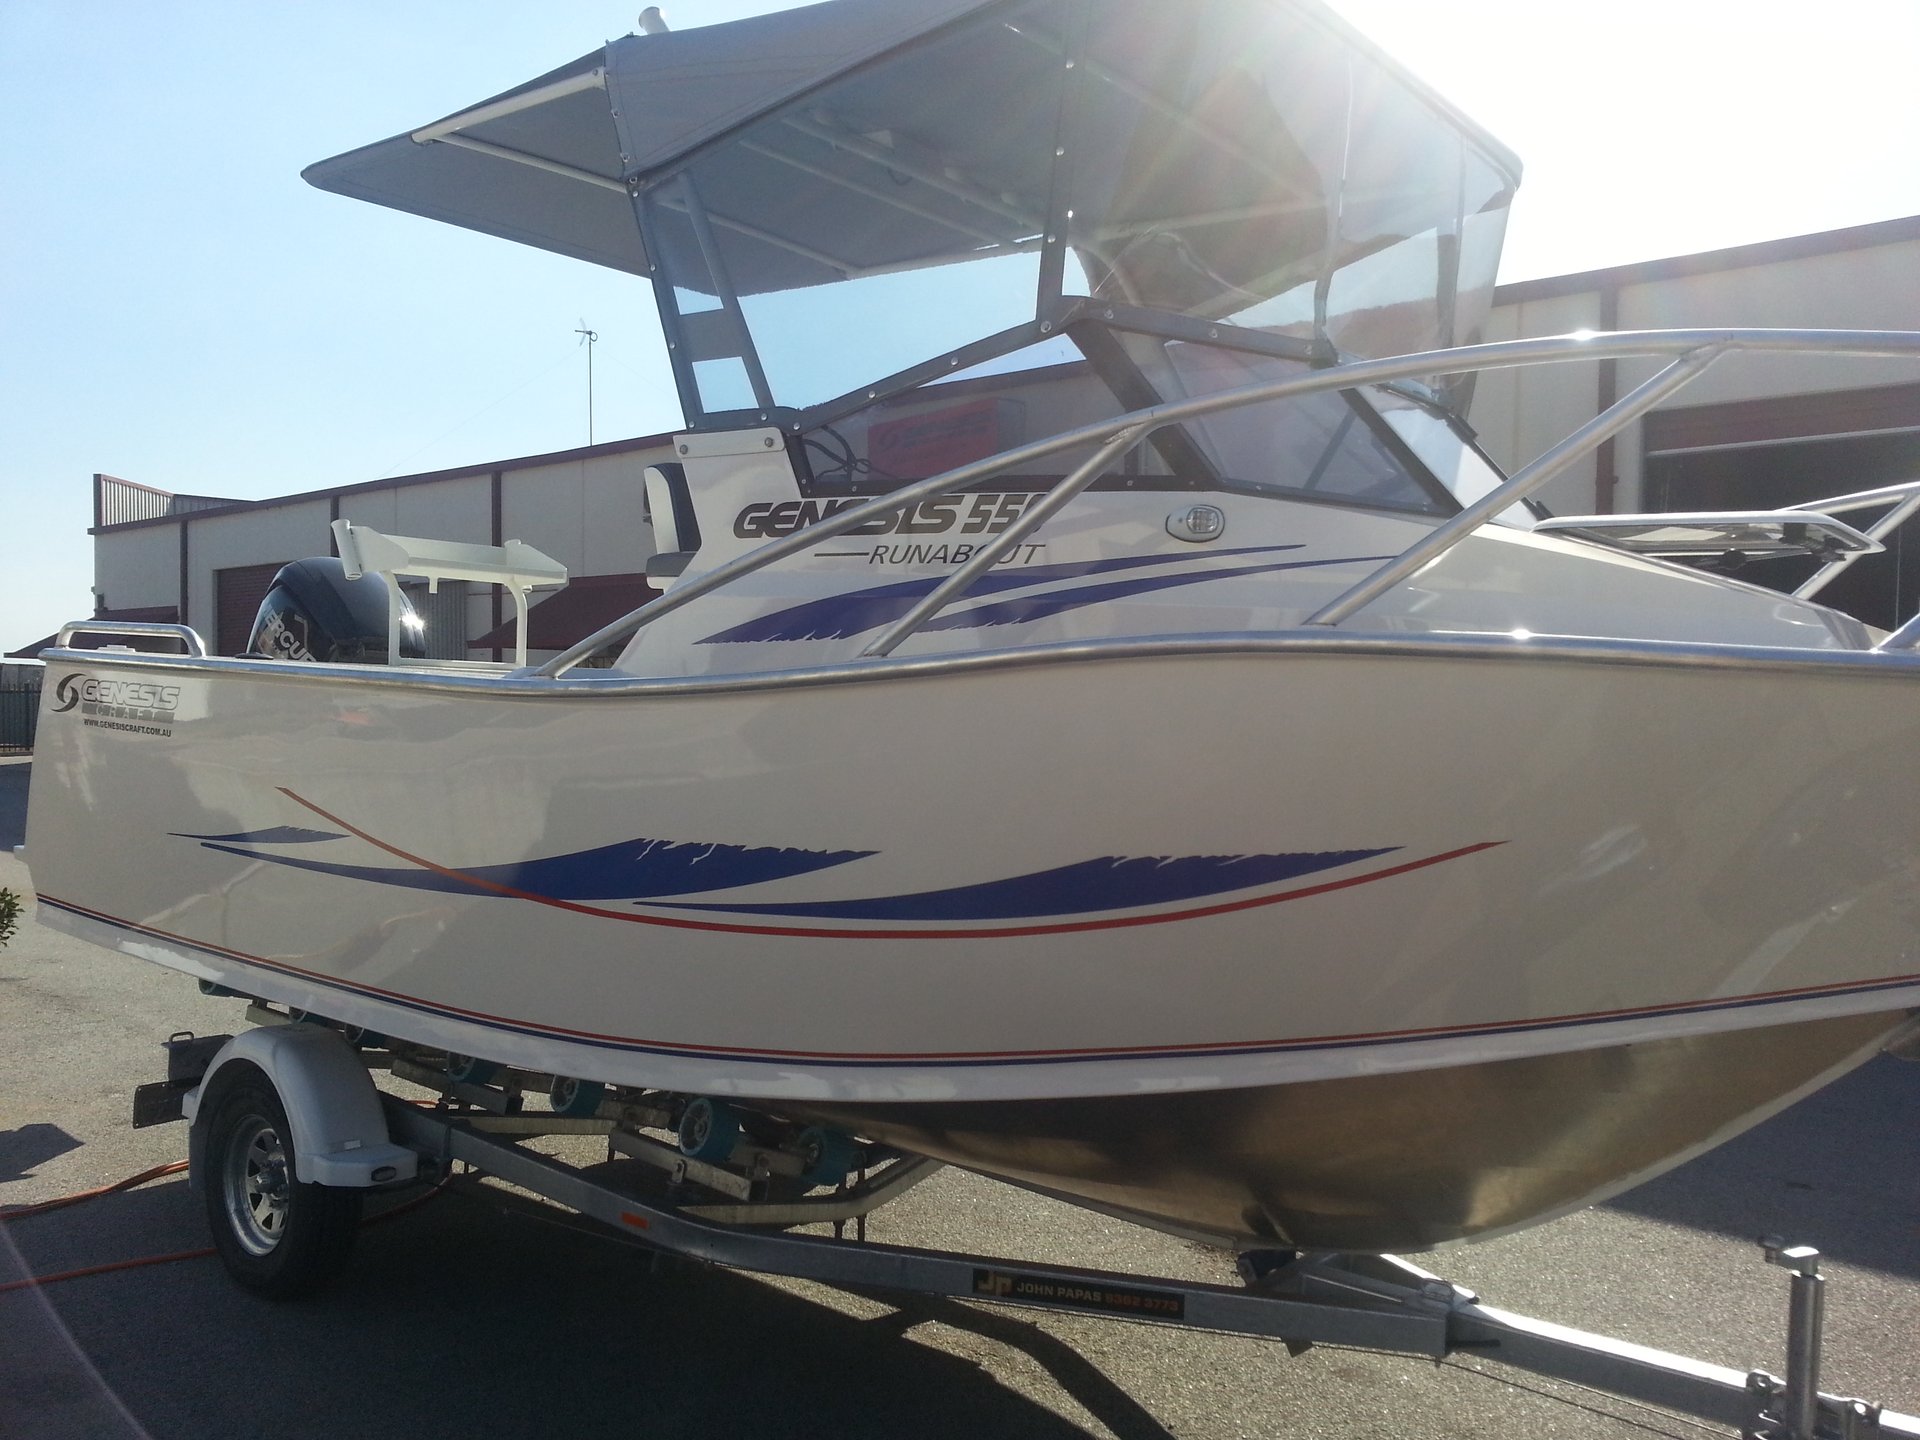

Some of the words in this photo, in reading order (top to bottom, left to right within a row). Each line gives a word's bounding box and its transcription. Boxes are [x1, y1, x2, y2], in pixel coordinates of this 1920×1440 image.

[868, 543, 1047, 565] RUNABUT
[81, 679, 181, 710] GENESIS
[83, 718, 172, 738] WWW.GENESISCRAFT.COM.AU
[1017, 1281, 1054, 1296] JOHN
[1057, 1287, 1101, 1303] PAPAS
